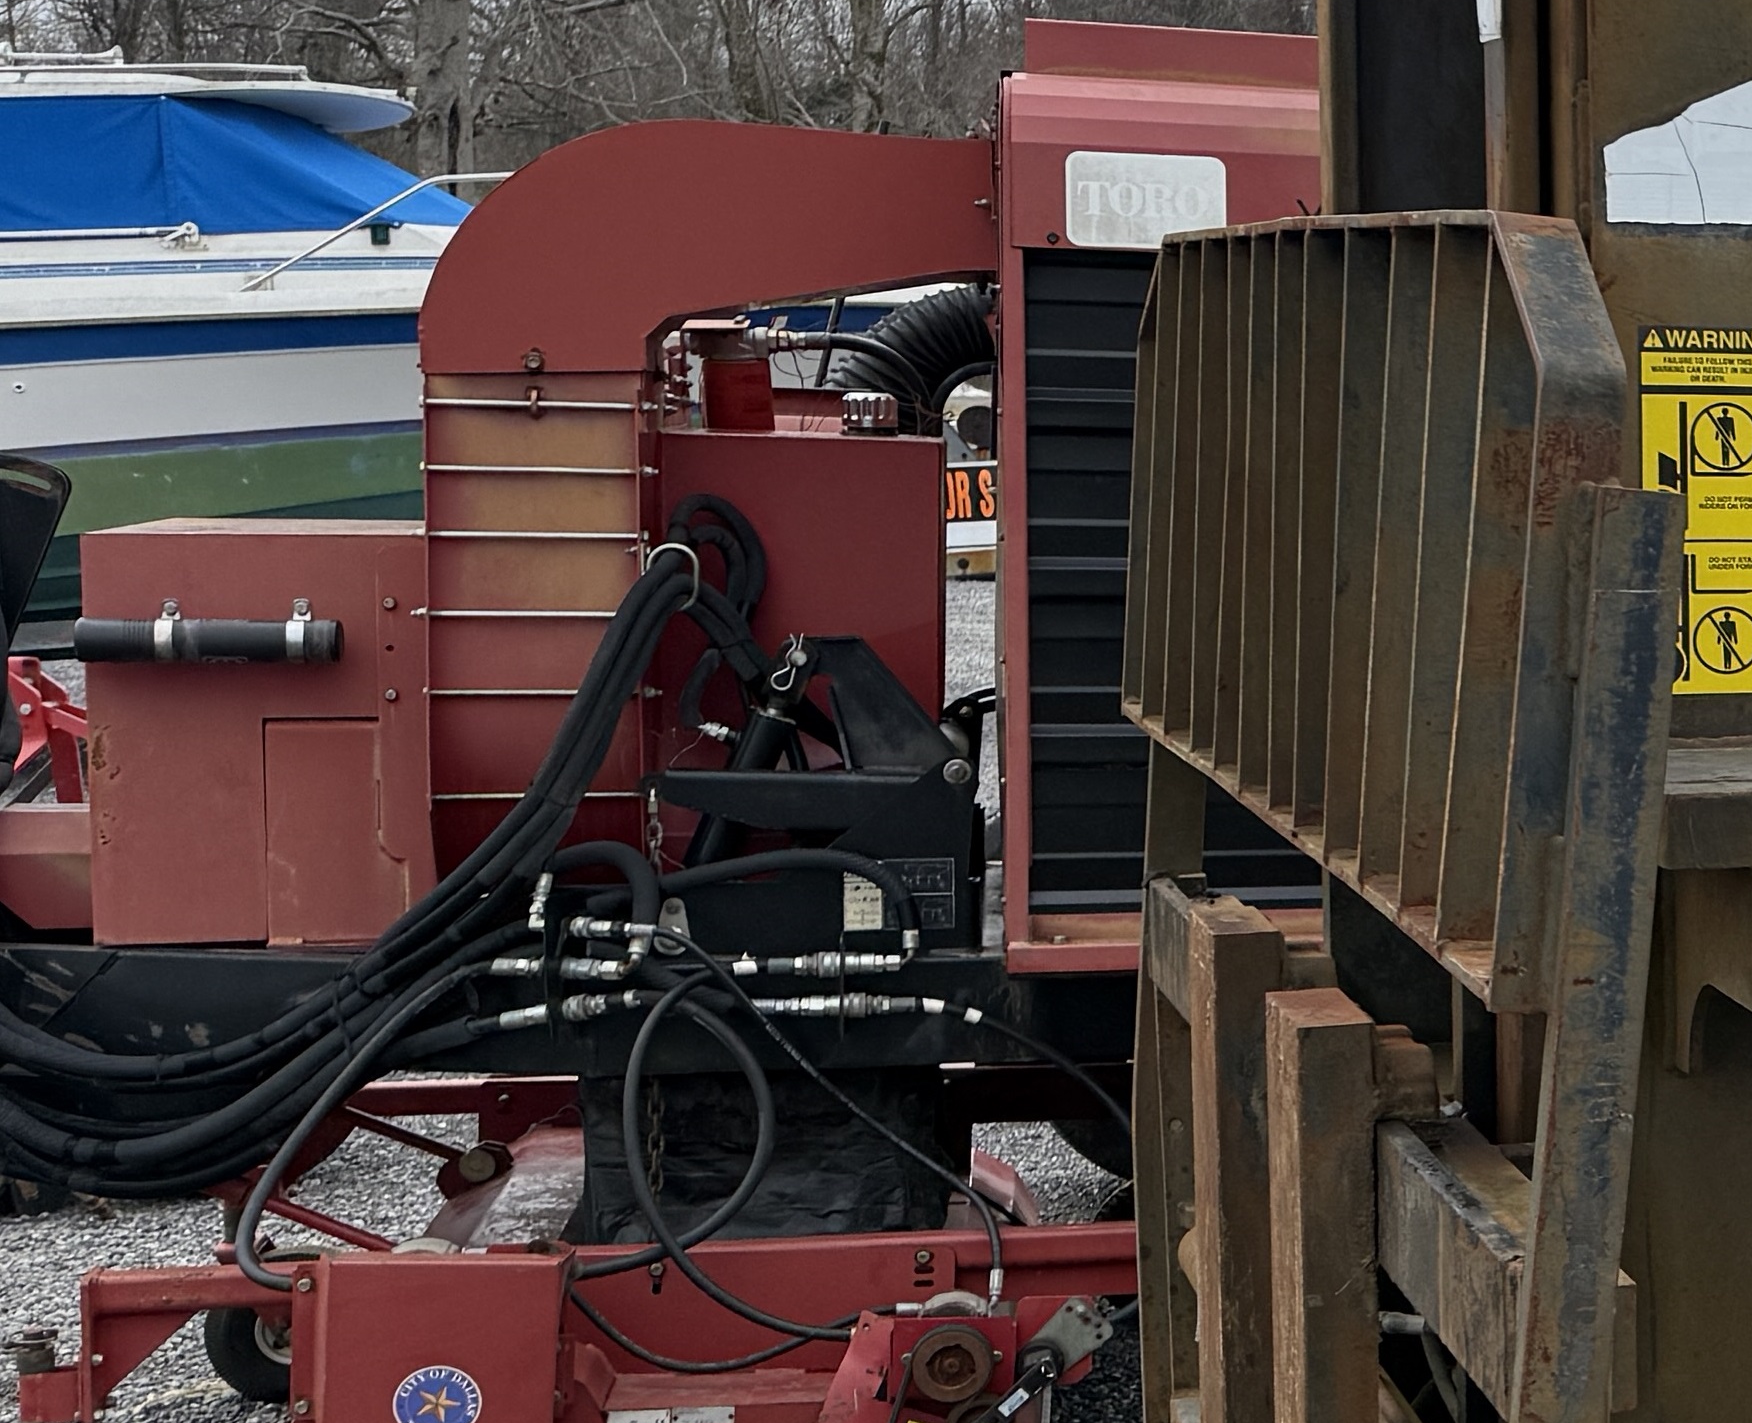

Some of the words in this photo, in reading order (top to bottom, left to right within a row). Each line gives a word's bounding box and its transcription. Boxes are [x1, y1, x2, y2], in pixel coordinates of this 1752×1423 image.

[1077, 180, 1209, 218] TORO
[399, 1373, 426, 1398] CITY
[429, 1369, 450, 1380] OF
[451, 1372, 478, 1418] DALLAS
